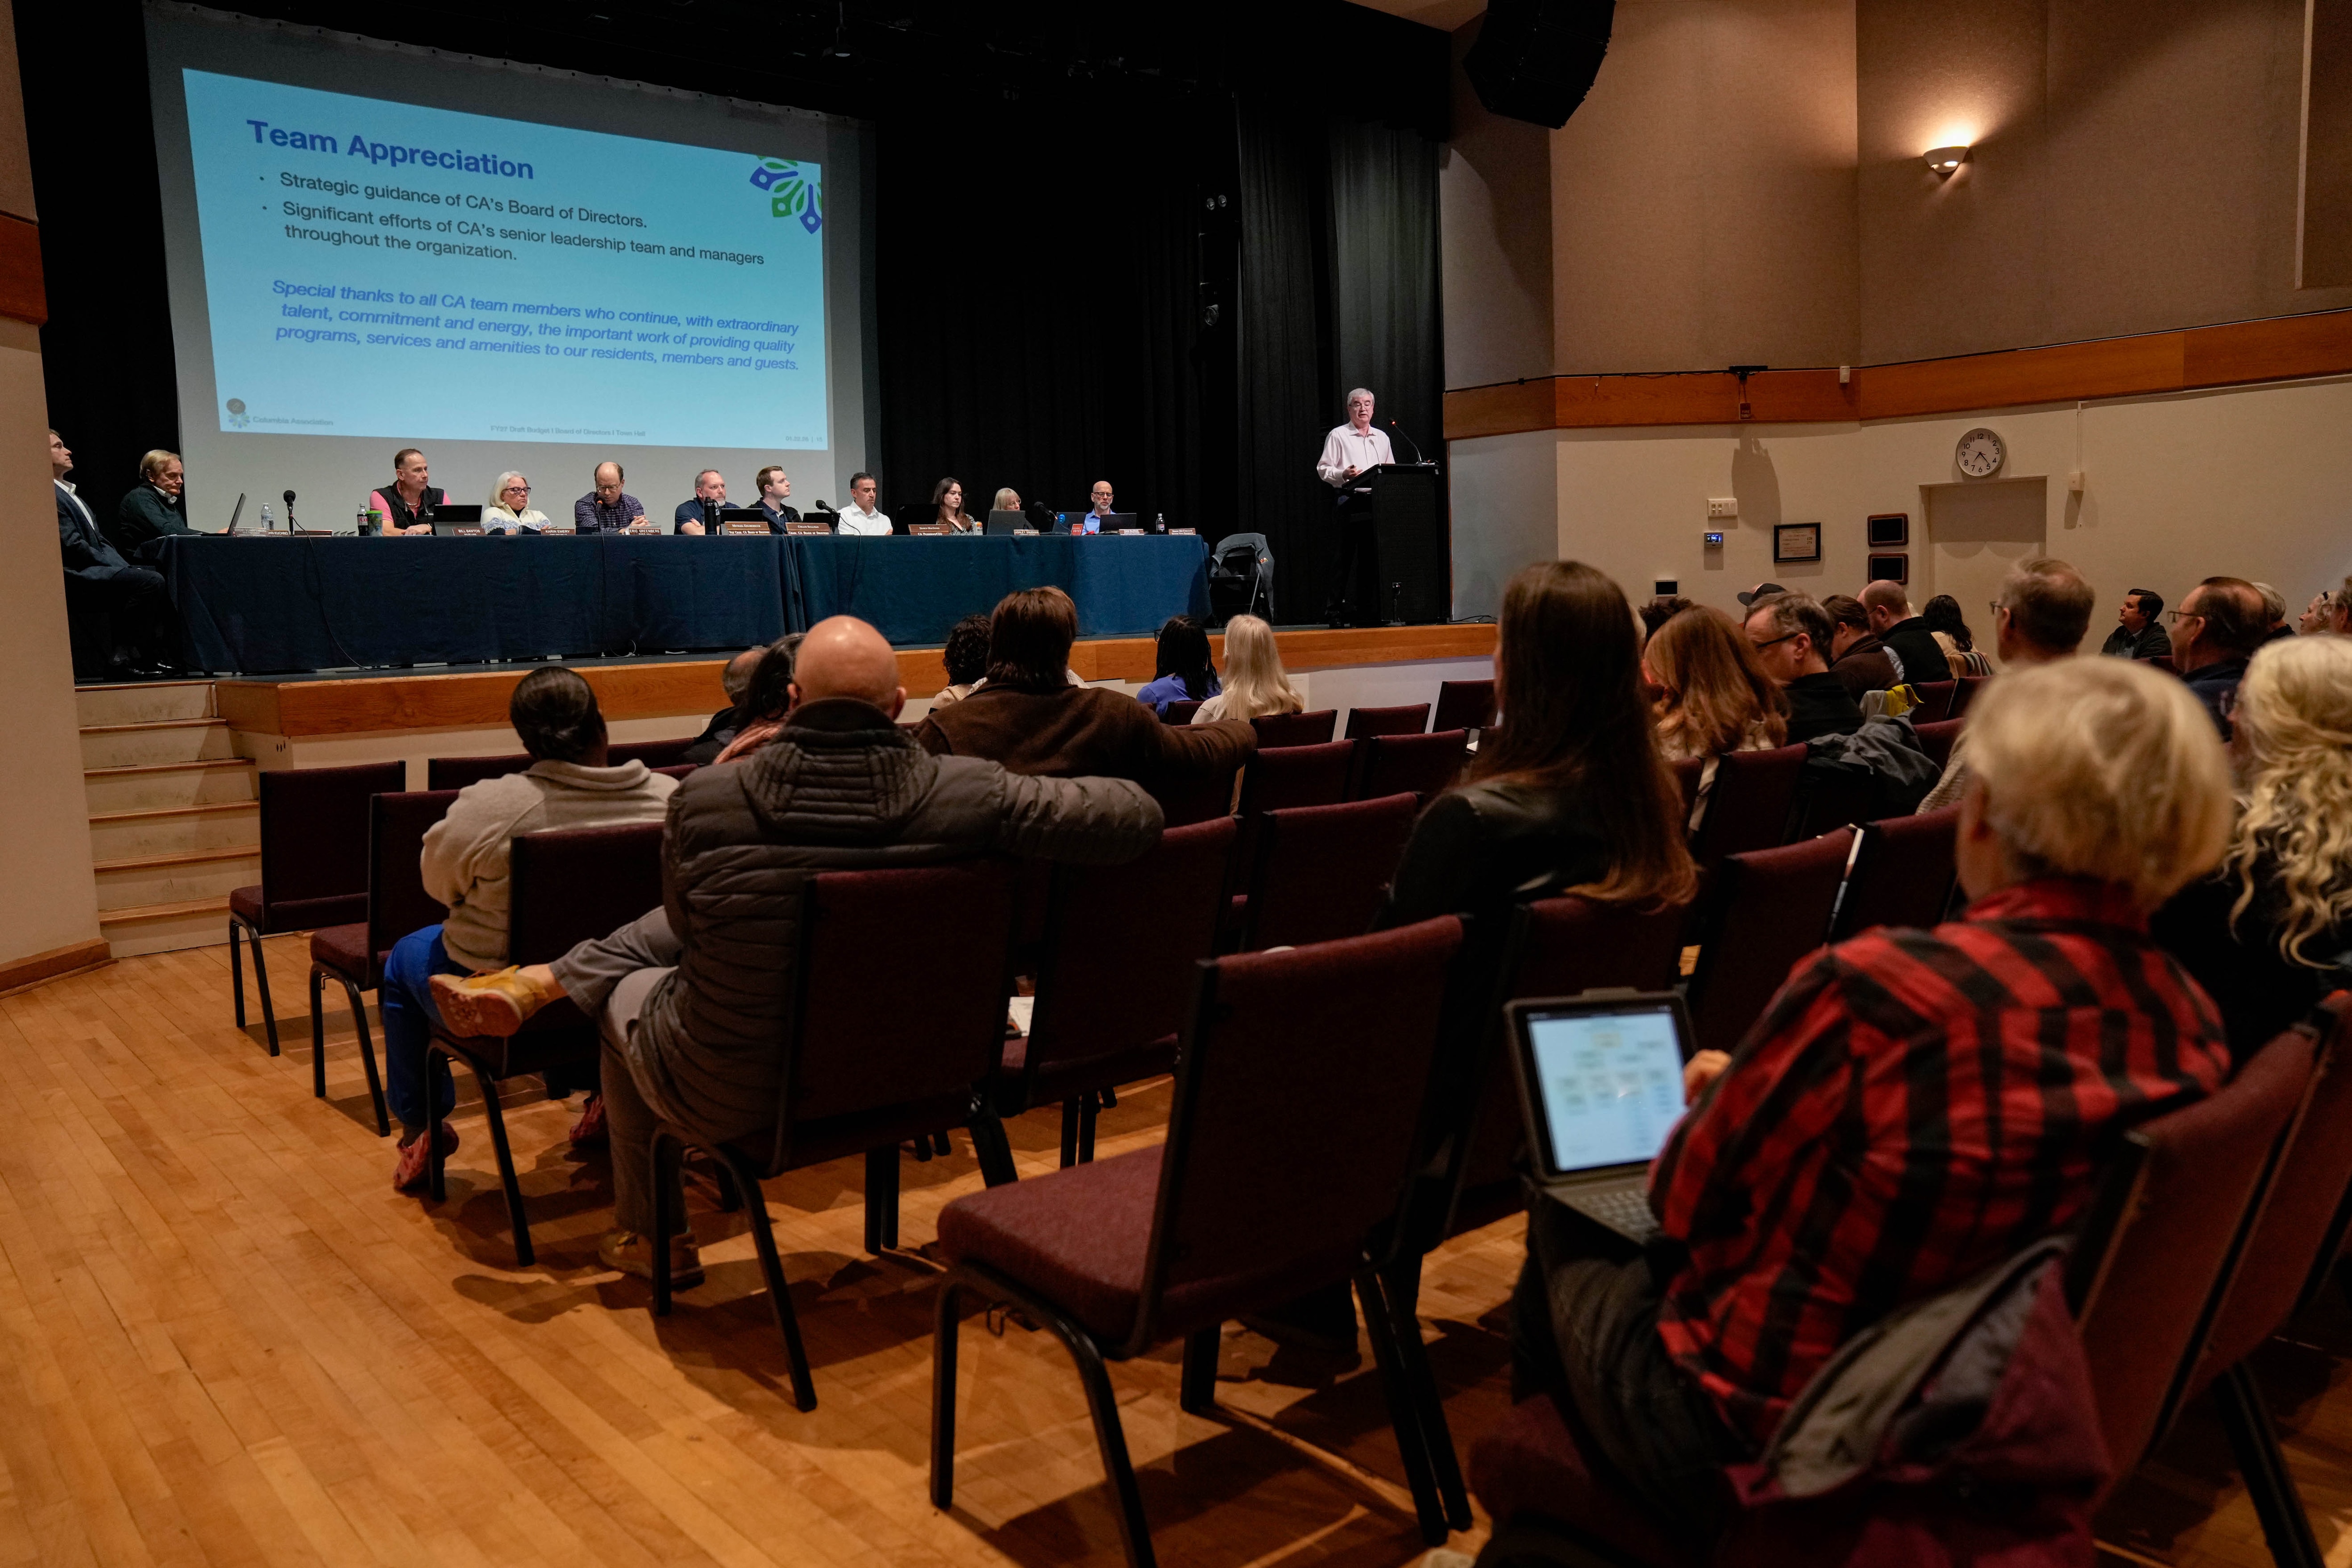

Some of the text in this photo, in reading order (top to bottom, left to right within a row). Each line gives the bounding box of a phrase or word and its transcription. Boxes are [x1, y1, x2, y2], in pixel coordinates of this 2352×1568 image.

[246, 119, 533, 179] Team Appreciation
[280, 172, 647, 228] Strategic guidance of CA's Board of Directors.
[283, 201, 764, 265] Significant efforts of CA's senior leadership team and managers
[285, 224, 516, 260] throughout the organization.
[272, 280, 799, 336] Special thanks to all CA team members who continue, with extraordinary
[282, 304, 795, 354] talent, commitment and energy, the important work of providing quality
[276, 327, 798, 370] programs, services and amenities to our residents, members and guests.
